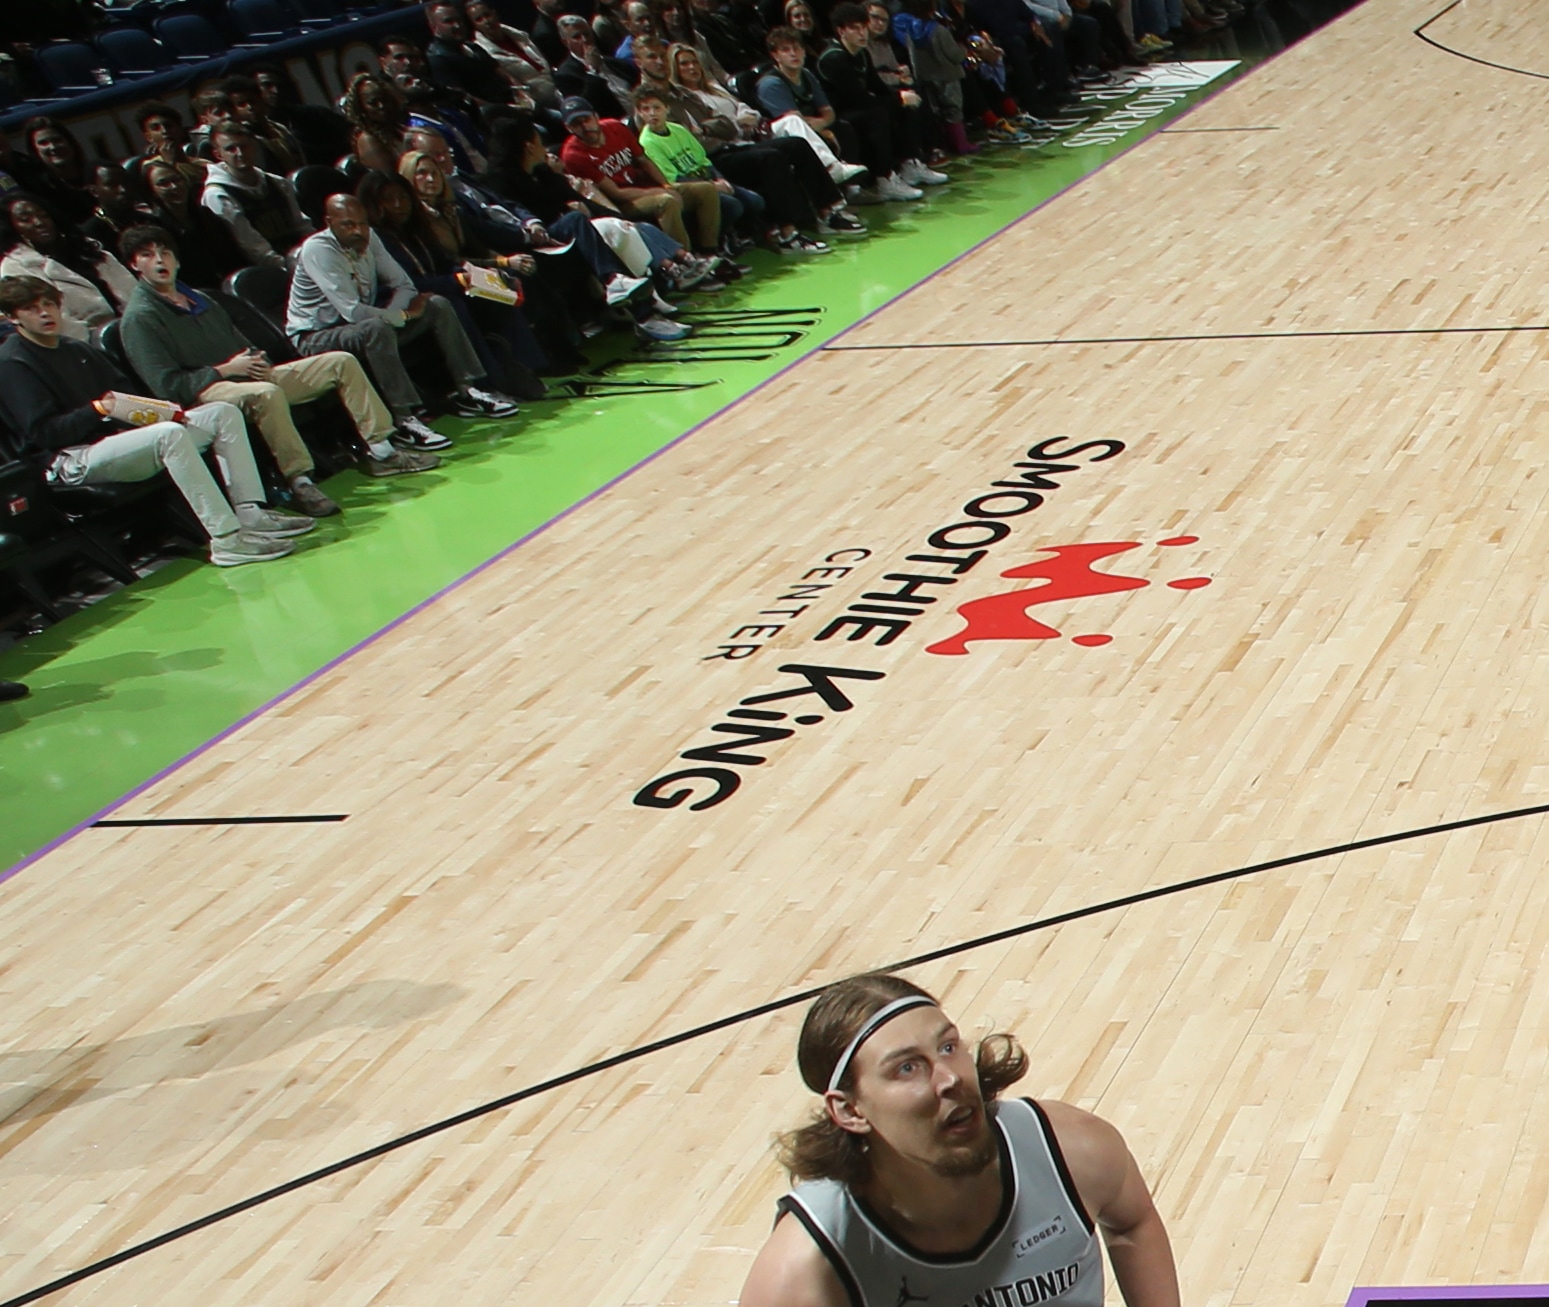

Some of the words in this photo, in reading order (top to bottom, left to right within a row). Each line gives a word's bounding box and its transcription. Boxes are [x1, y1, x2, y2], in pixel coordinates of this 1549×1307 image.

[814, 434, 1126, 647] SMOOTHIE
[702, 547, 871, 663] CENTER
[1020, 1223, 1059, 1251] LEDGER
